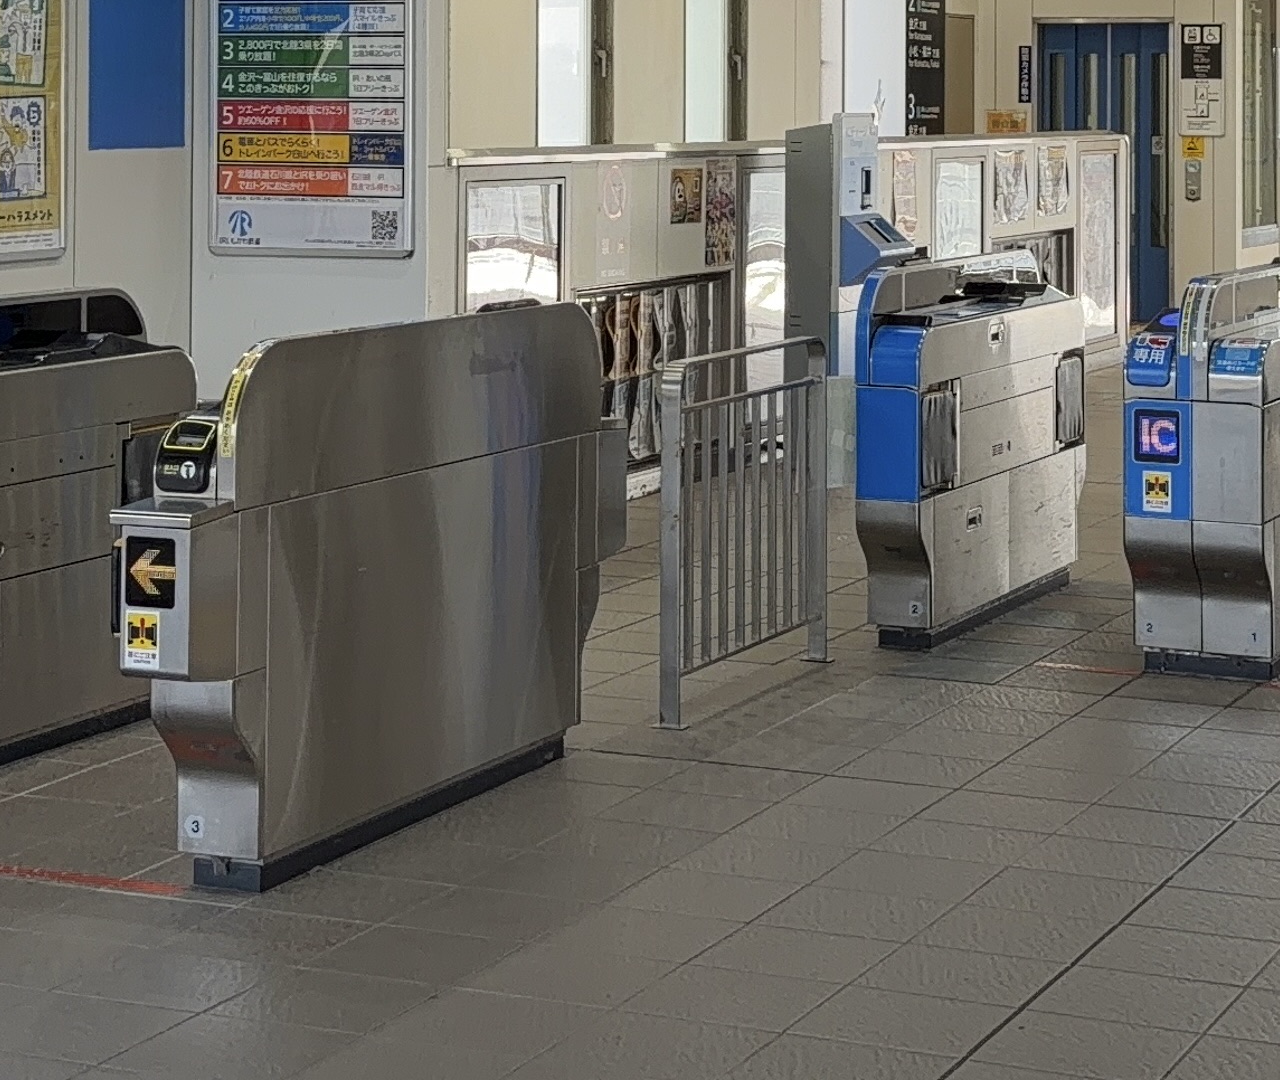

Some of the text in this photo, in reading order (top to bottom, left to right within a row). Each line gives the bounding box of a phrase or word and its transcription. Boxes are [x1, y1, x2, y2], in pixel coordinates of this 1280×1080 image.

[223, 9, 234, 28] 2
[223, 41, 234, 60] 3
[222, 73, 234, 92] 4
[908, 93, 915, 119] 3
[222, 106, 233, 125] 5
[223, 139, 233, 157] 6
[221, 171, 233, 189] 7
[1133, 348, 1165, 365] 専用
[1141, 418, 1178, 453] IC
[911, 604, 919, 614] 2
[1145, 623, 1153, 633] 2
[1251, 633, 1257, 643] 1
[191, 820, 200, 833] 3
